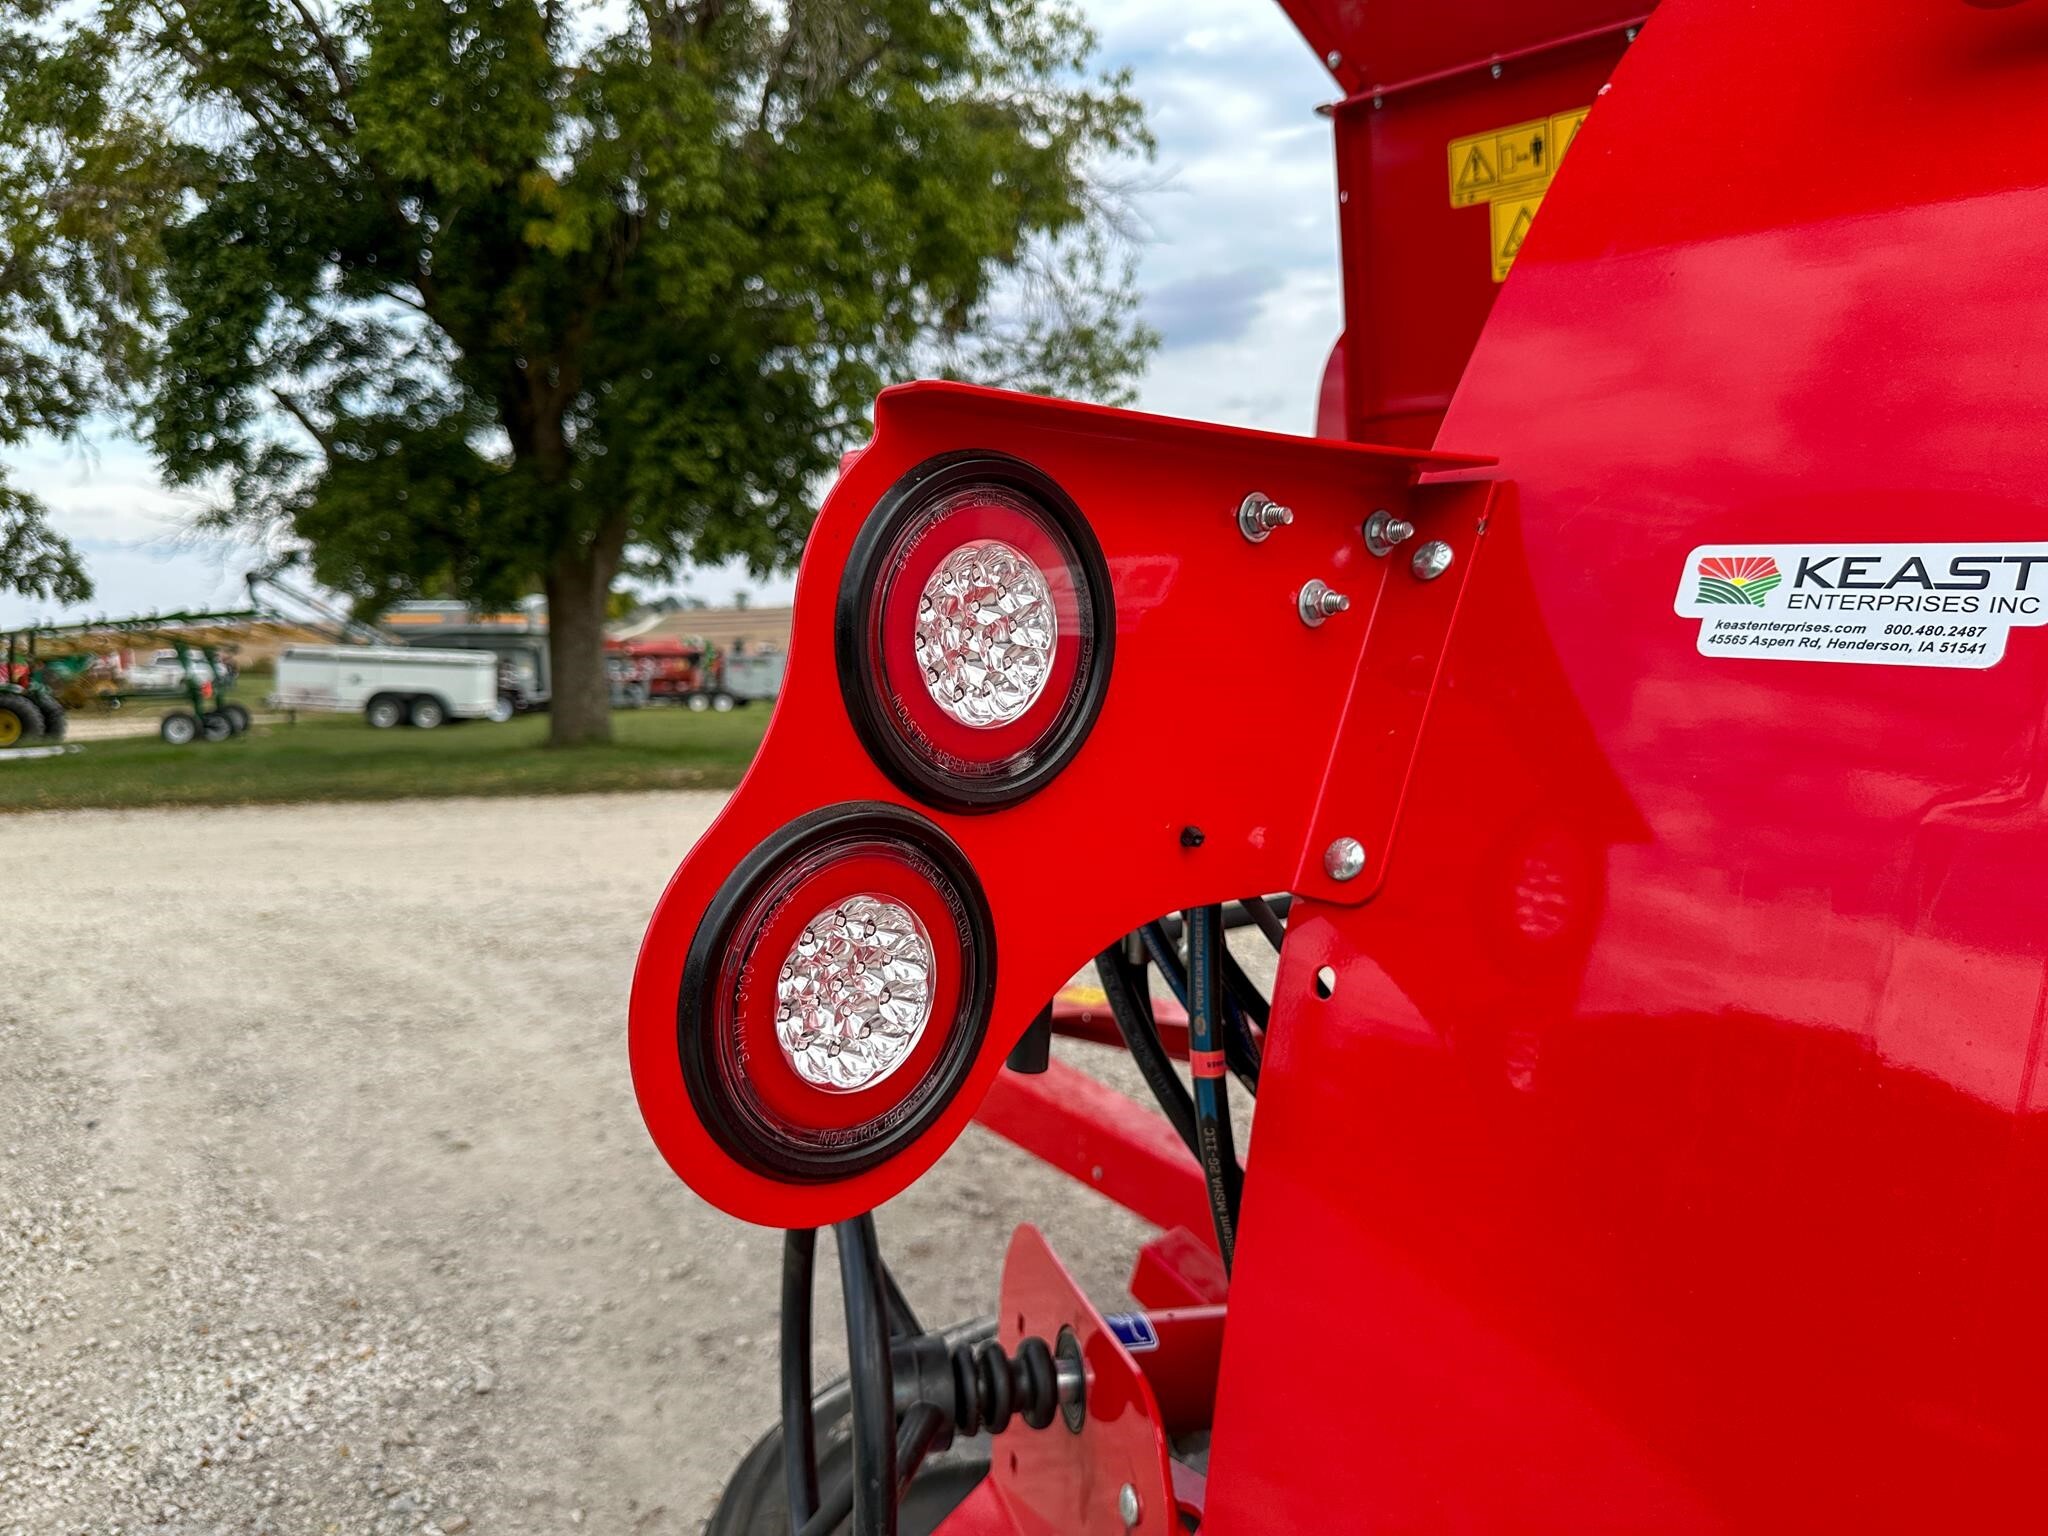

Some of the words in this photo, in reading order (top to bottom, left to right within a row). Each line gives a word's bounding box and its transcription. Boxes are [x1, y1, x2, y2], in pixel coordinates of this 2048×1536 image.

[1793, 556, 2048, 591] KEAST
[1787, 594, 1980, 614] ENTERPRISES
[1989, 596, 2041, 614] INC
[1707, 634, 1748, 646] 45565
[1749, 636, 1795, 649] Aspen
[1798, 637, 1822, 650] Rd,
[1826, 639, 1914, 653] Henderson,
[1917, 641, 1935, 653] IA
[1939, 642, 1987, 655] 51541
[1714, 619, 1867, 635] keastenterprises.com
[1883, 624, 1987, 638] 800.480.2487
[892, 693, 934, 755] INDUSTRIA
[735, 965, 755, 1002] 3100
[1211, 1175, 1228, 1212] MSHA
